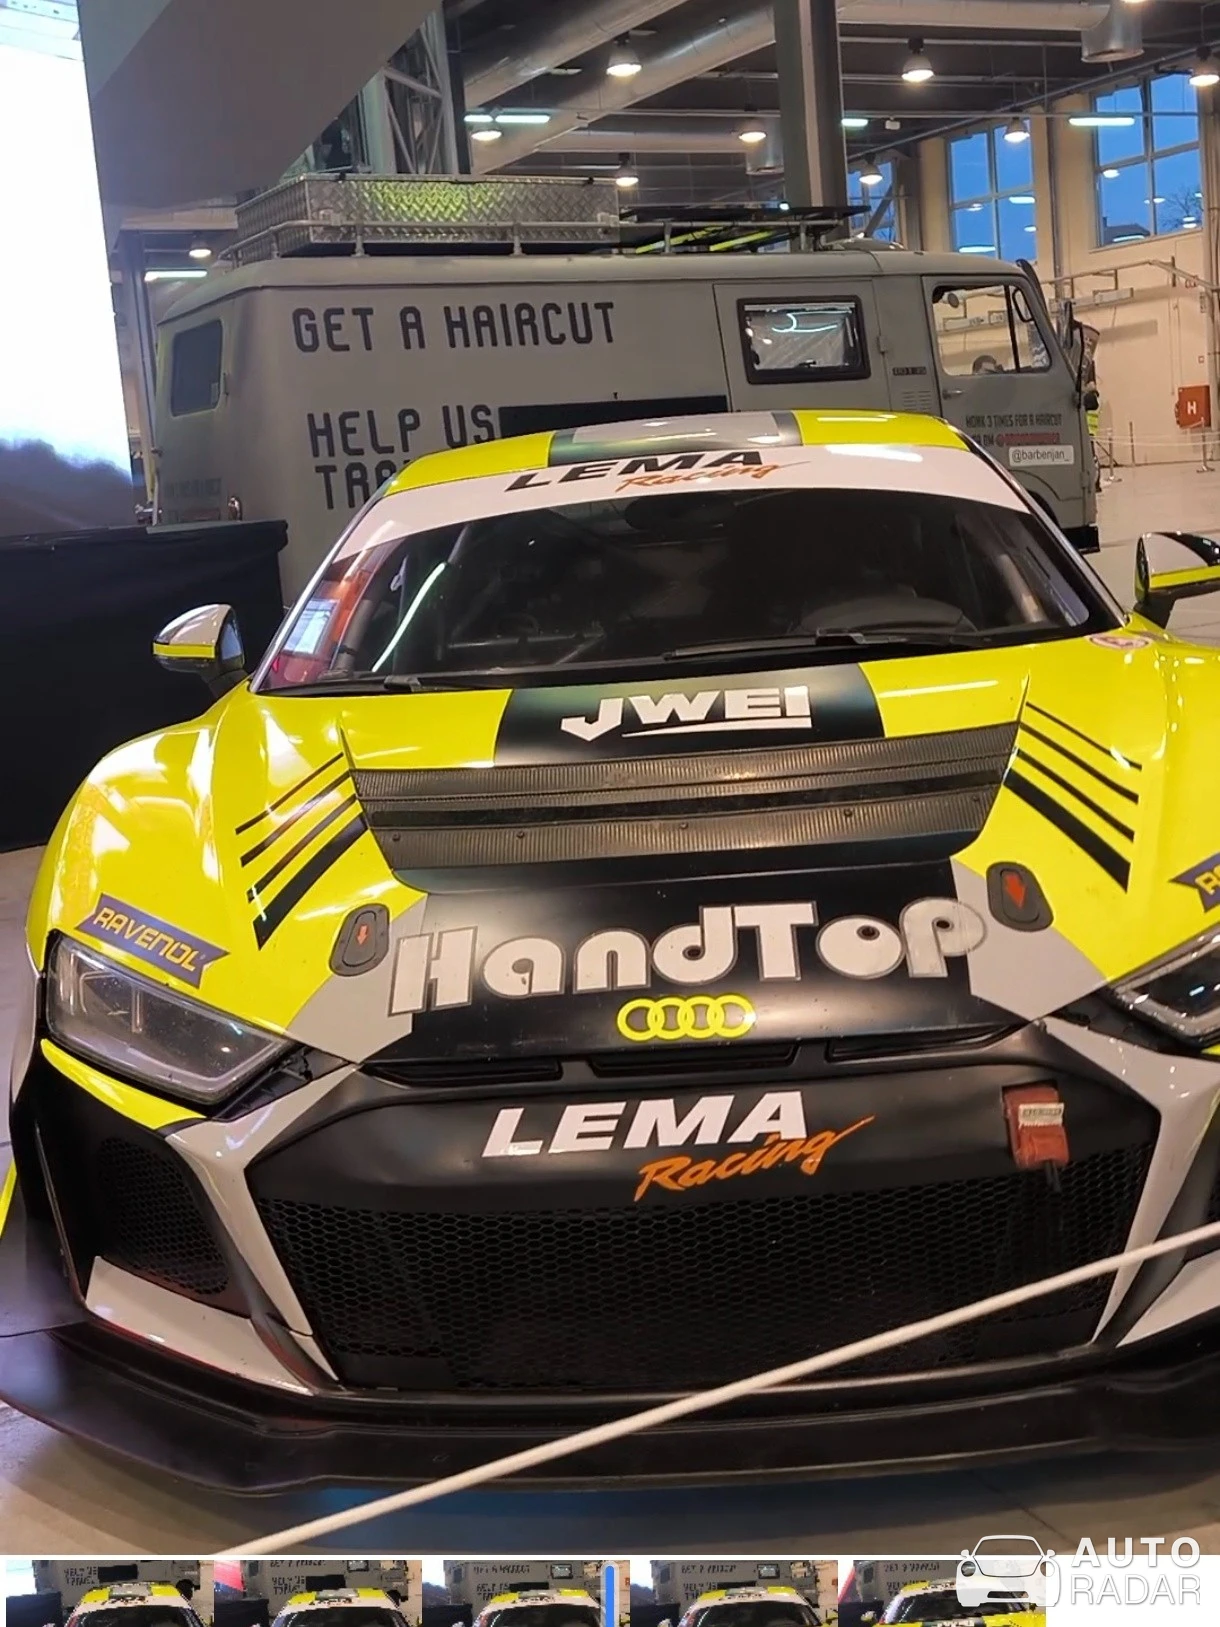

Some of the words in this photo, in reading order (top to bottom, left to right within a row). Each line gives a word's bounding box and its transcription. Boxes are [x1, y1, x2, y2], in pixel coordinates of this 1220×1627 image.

[292, 307, 374, 352] GET
[400, 306, 426, 350] A
[443, 302, 614, 348] HAIRCUT
[307, 408, 420, 457] HELP
[442, 404, 496, 449] US
[1187, 400, 1197, 415] H
[504, 451, 764, 492] LEMA
[615, 461, 811, 492] Racing
[560, 686, 812, 742] JWEI
[93, 907, 199, 972] RAVENOL
[482, 1091, 808, 1158] LEMA
[633, 1114, 875, 1201] Racing
